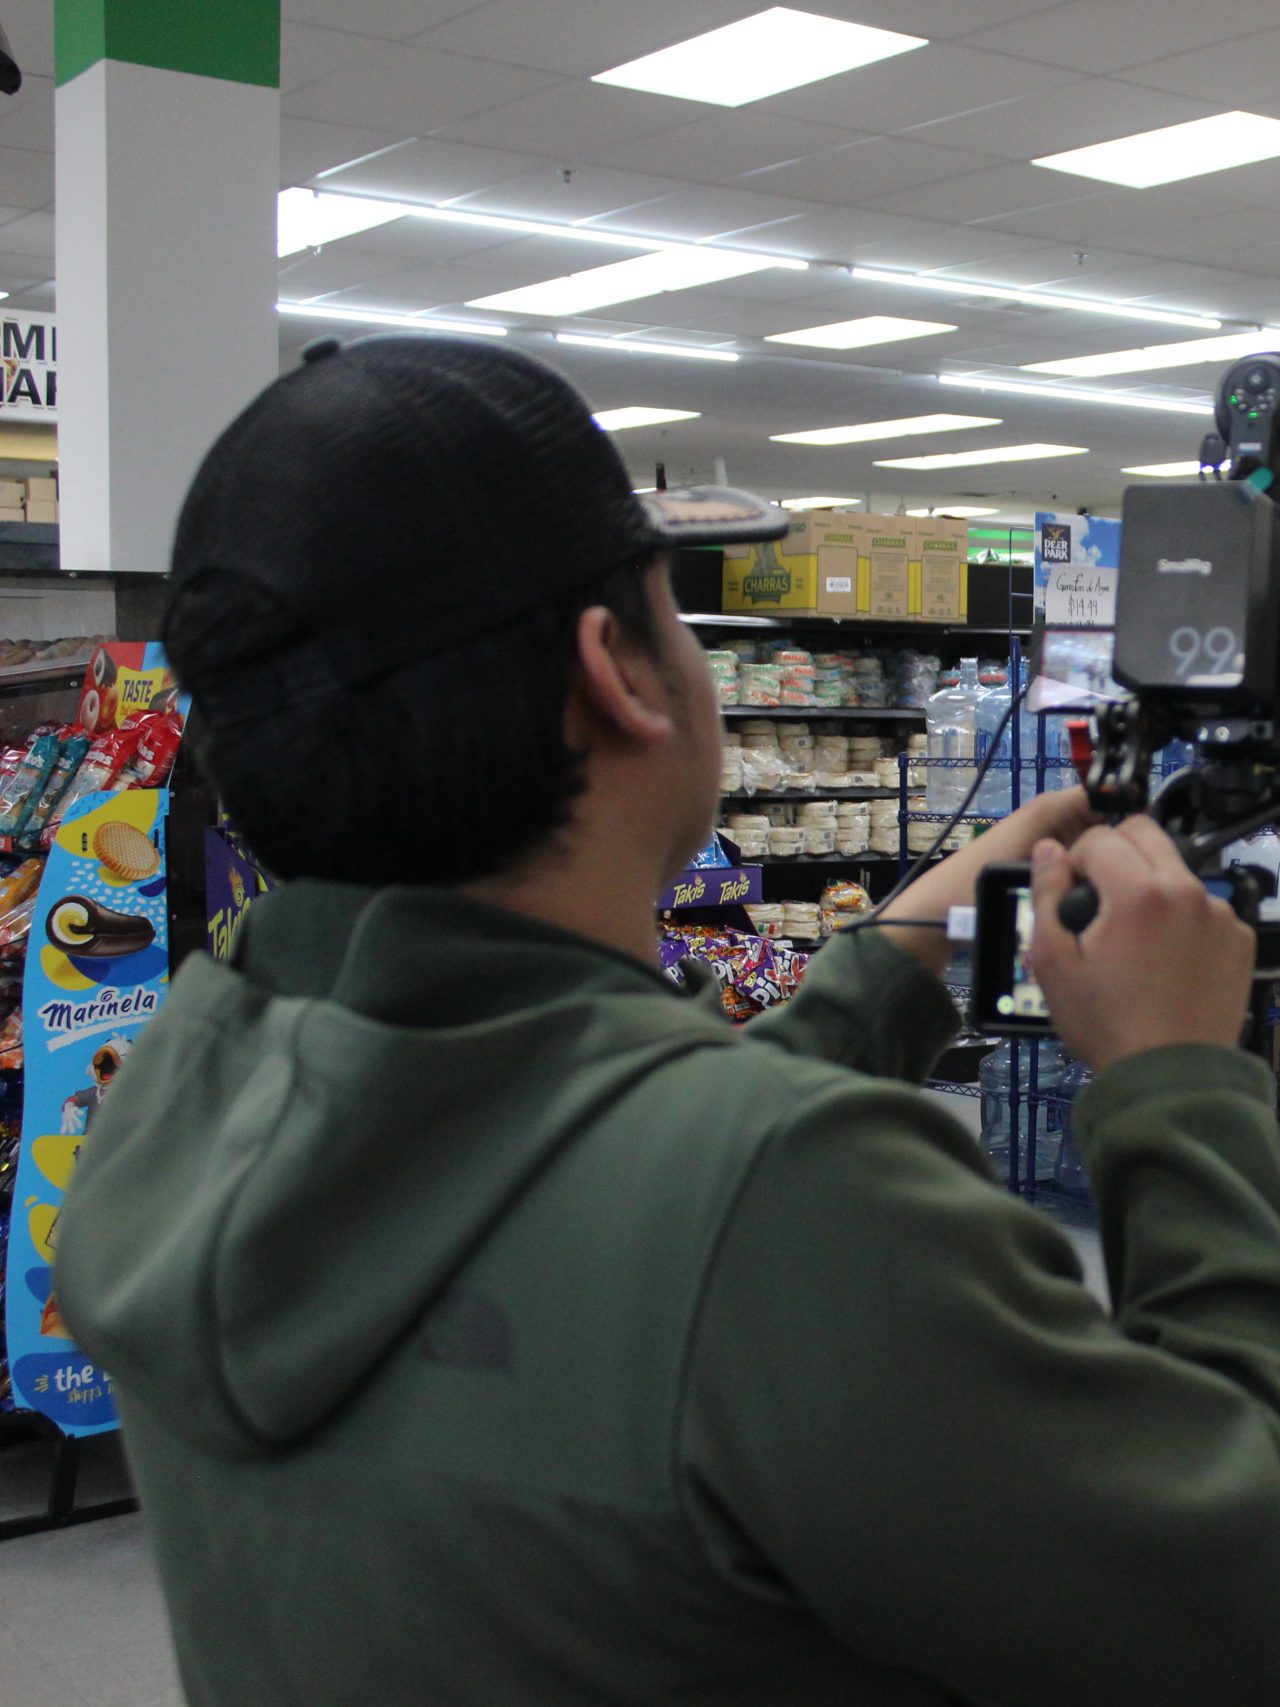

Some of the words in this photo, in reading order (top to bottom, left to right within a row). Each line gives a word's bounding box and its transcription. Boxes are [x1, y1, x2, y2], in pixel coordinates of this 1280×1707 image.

[1044, 539, 1068, 550] DEER
[1044, 549, 1068, 560] PARK
[743, 574, 789, 594] CHARRAS
[1169, 626, 1236, 681] 99
[122, 679, 153, 702] TASTE
[673, 881, 706, 908] Takis
[719, 879, 750, 905] Takis
[42, 988, 155, 1029] Marinela
[54, 1365, 94, 1392] the
